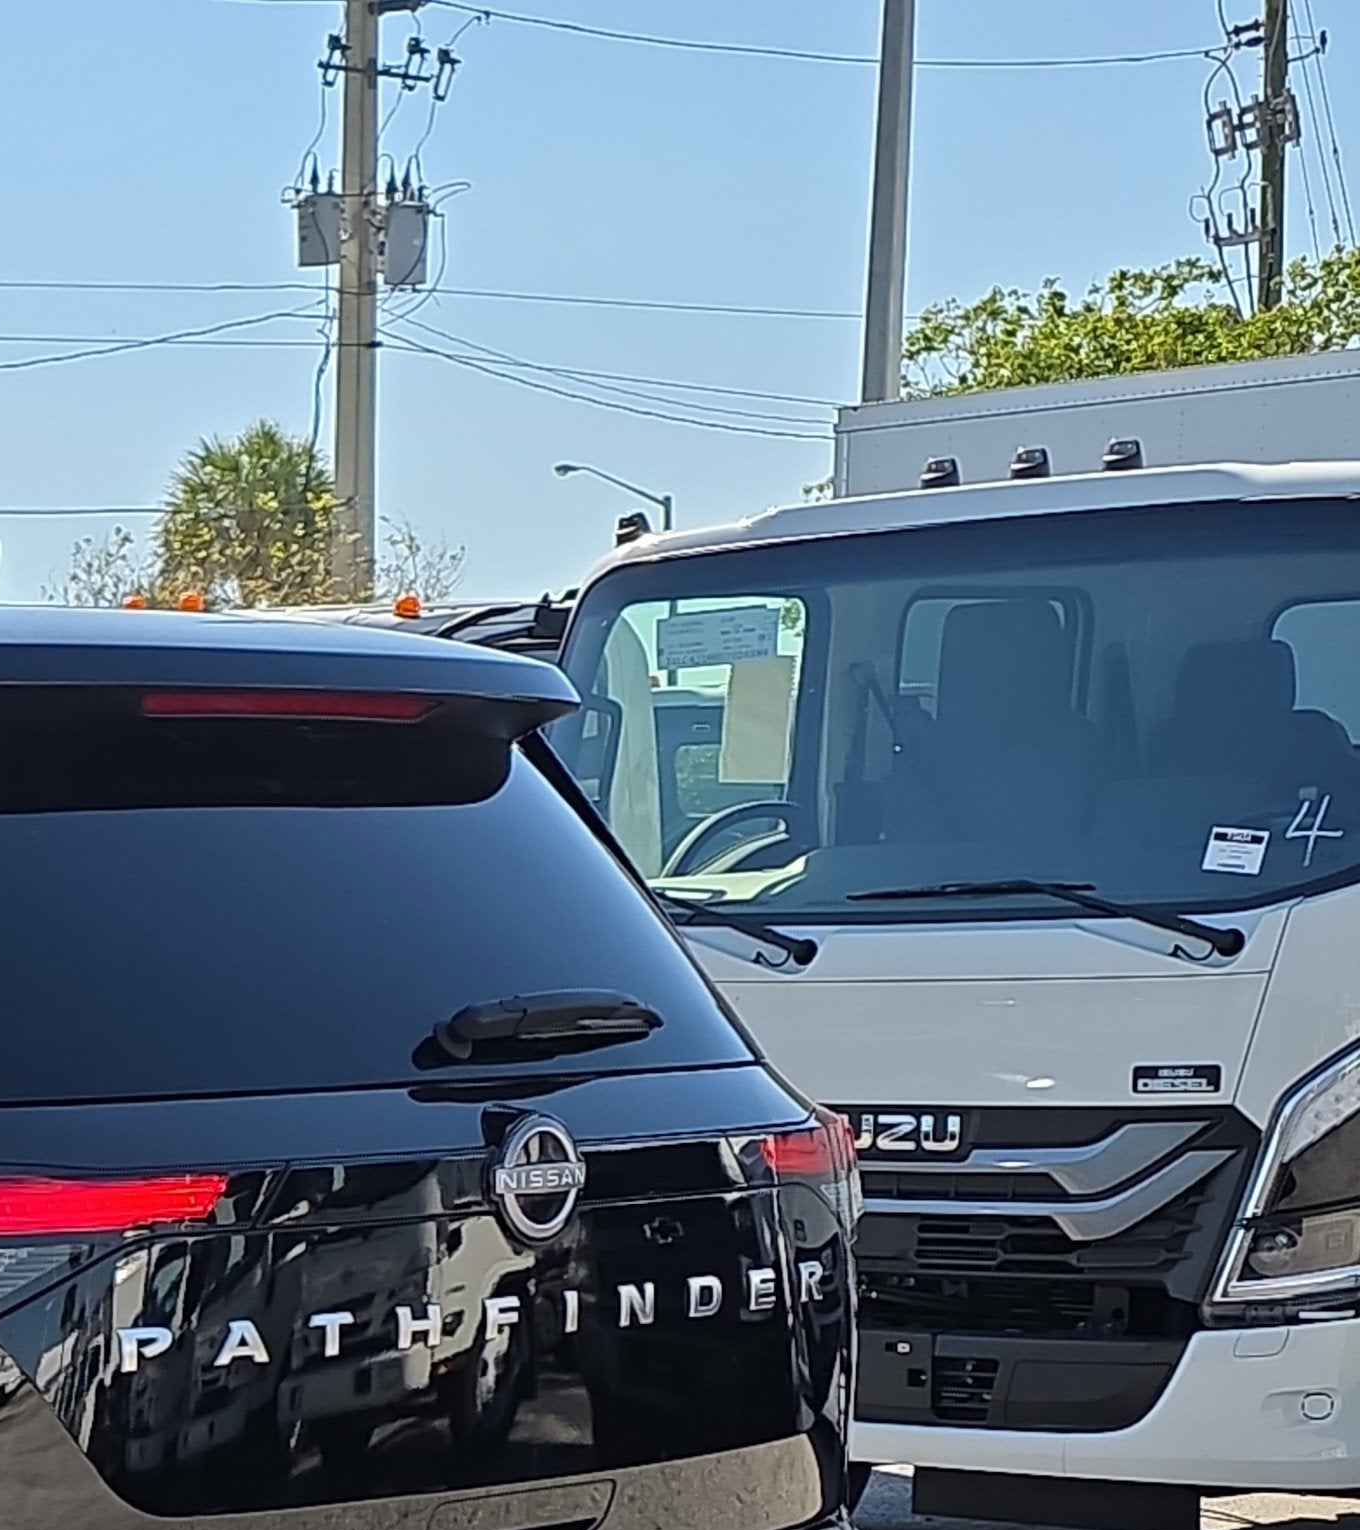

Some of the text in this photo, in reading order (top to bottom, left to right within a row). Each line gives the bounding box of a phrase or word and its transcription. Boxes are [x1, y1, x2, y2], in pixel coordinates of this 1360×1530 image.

[1285, 794, 1344, 867] 4
[498, 1165, 585, 1190] NISSAN
[116, 1259, 827, 1375] PATHFINDER
